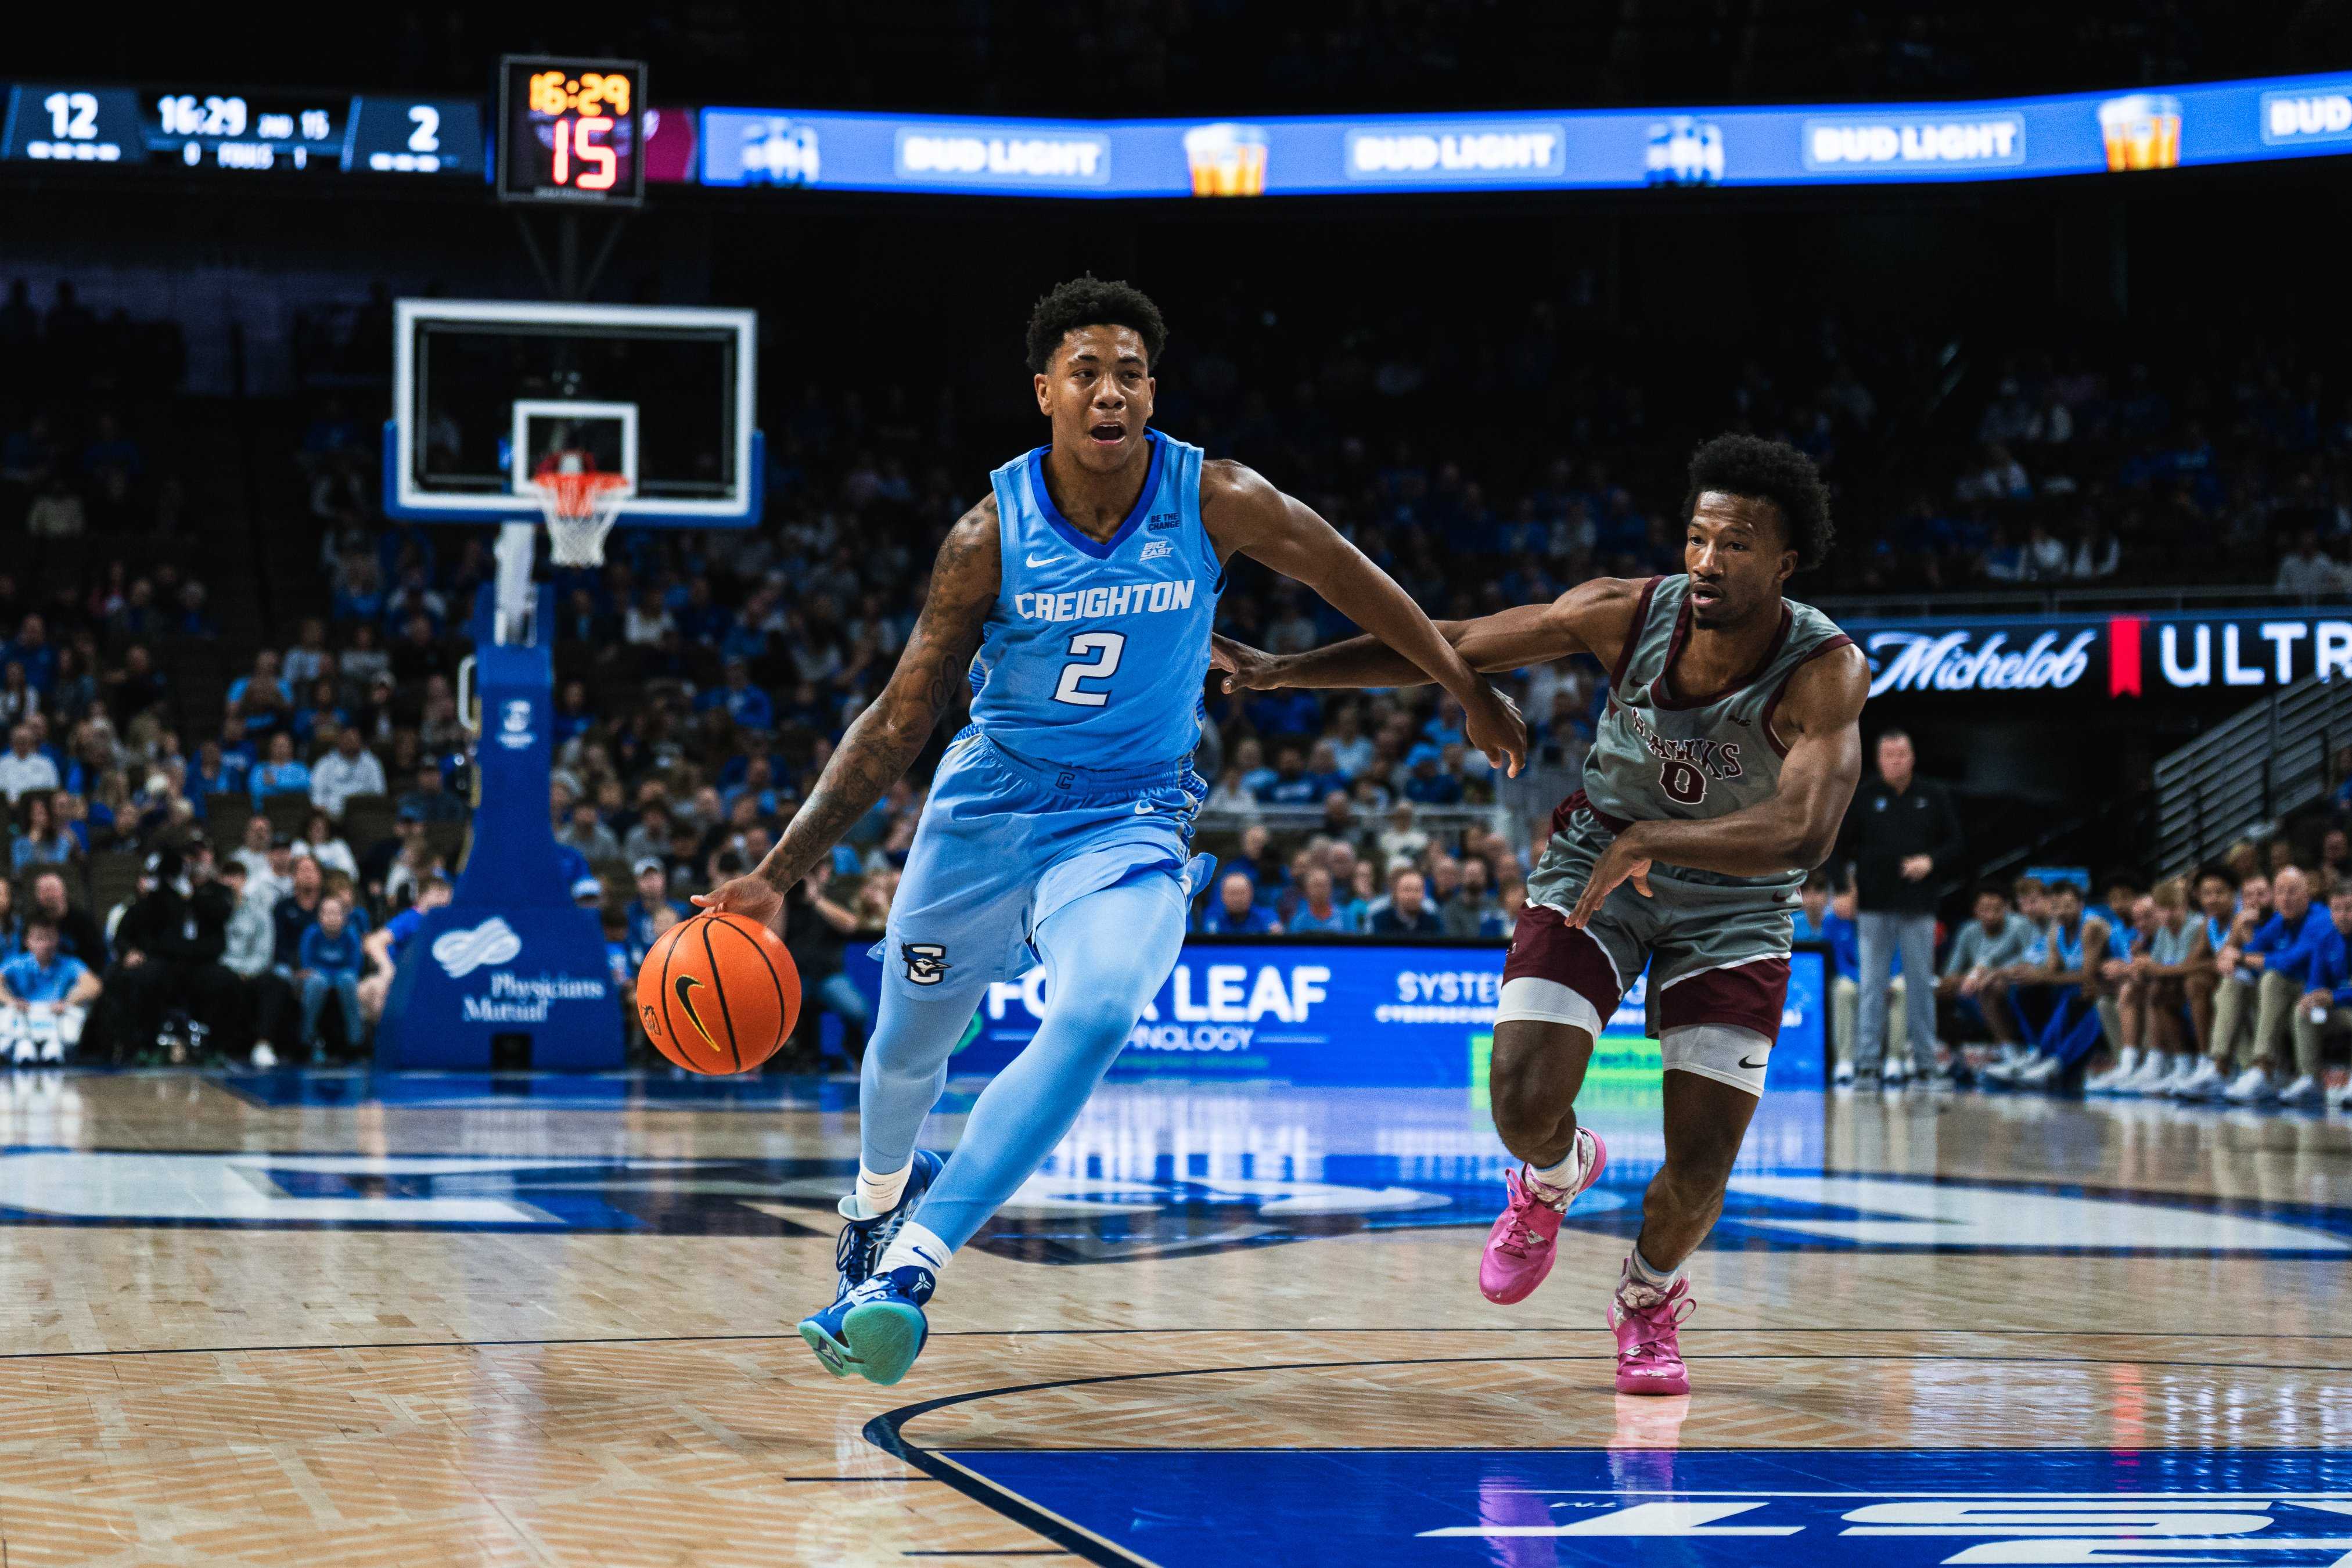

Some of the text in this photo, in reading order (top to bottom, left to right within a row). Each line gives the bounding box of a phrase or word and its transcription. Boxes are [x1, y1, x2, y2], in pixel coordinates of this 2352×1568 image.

[529, 71, 630, 116] 16:29
[45, 92, 98, 139] 12
[157, 95, 247, 136] 16:29
[408, 106, 440, 152] 2
[2271, 96, 2352, 136] BUD
[552, 117, 617, 189] 15
[904, 136, 1098, 176] BUD LIGHT
[1355, 133, 1555, 171] BUD LIGHT
[1814, 121, 2017, 163] BUD LIGHT
[1149, 520, 1180, 531] CHANGE
[1151, 512, 1179, 523] BE THE
[1141, 548, 1174, 558] EAST
[1144, 541, 1168, 550] BIG
[1015, 580, 1195, 622] CREIGHTON
[1050, 630, 1128, 708] 2
[1867, 621, 2352, 698] Michelob ULTR
[1659, 761, 1707, 804] 0
[989, 964, 1331, 1023] FO LEAF
[1397, 971, 1503, 1003] SYSTE
